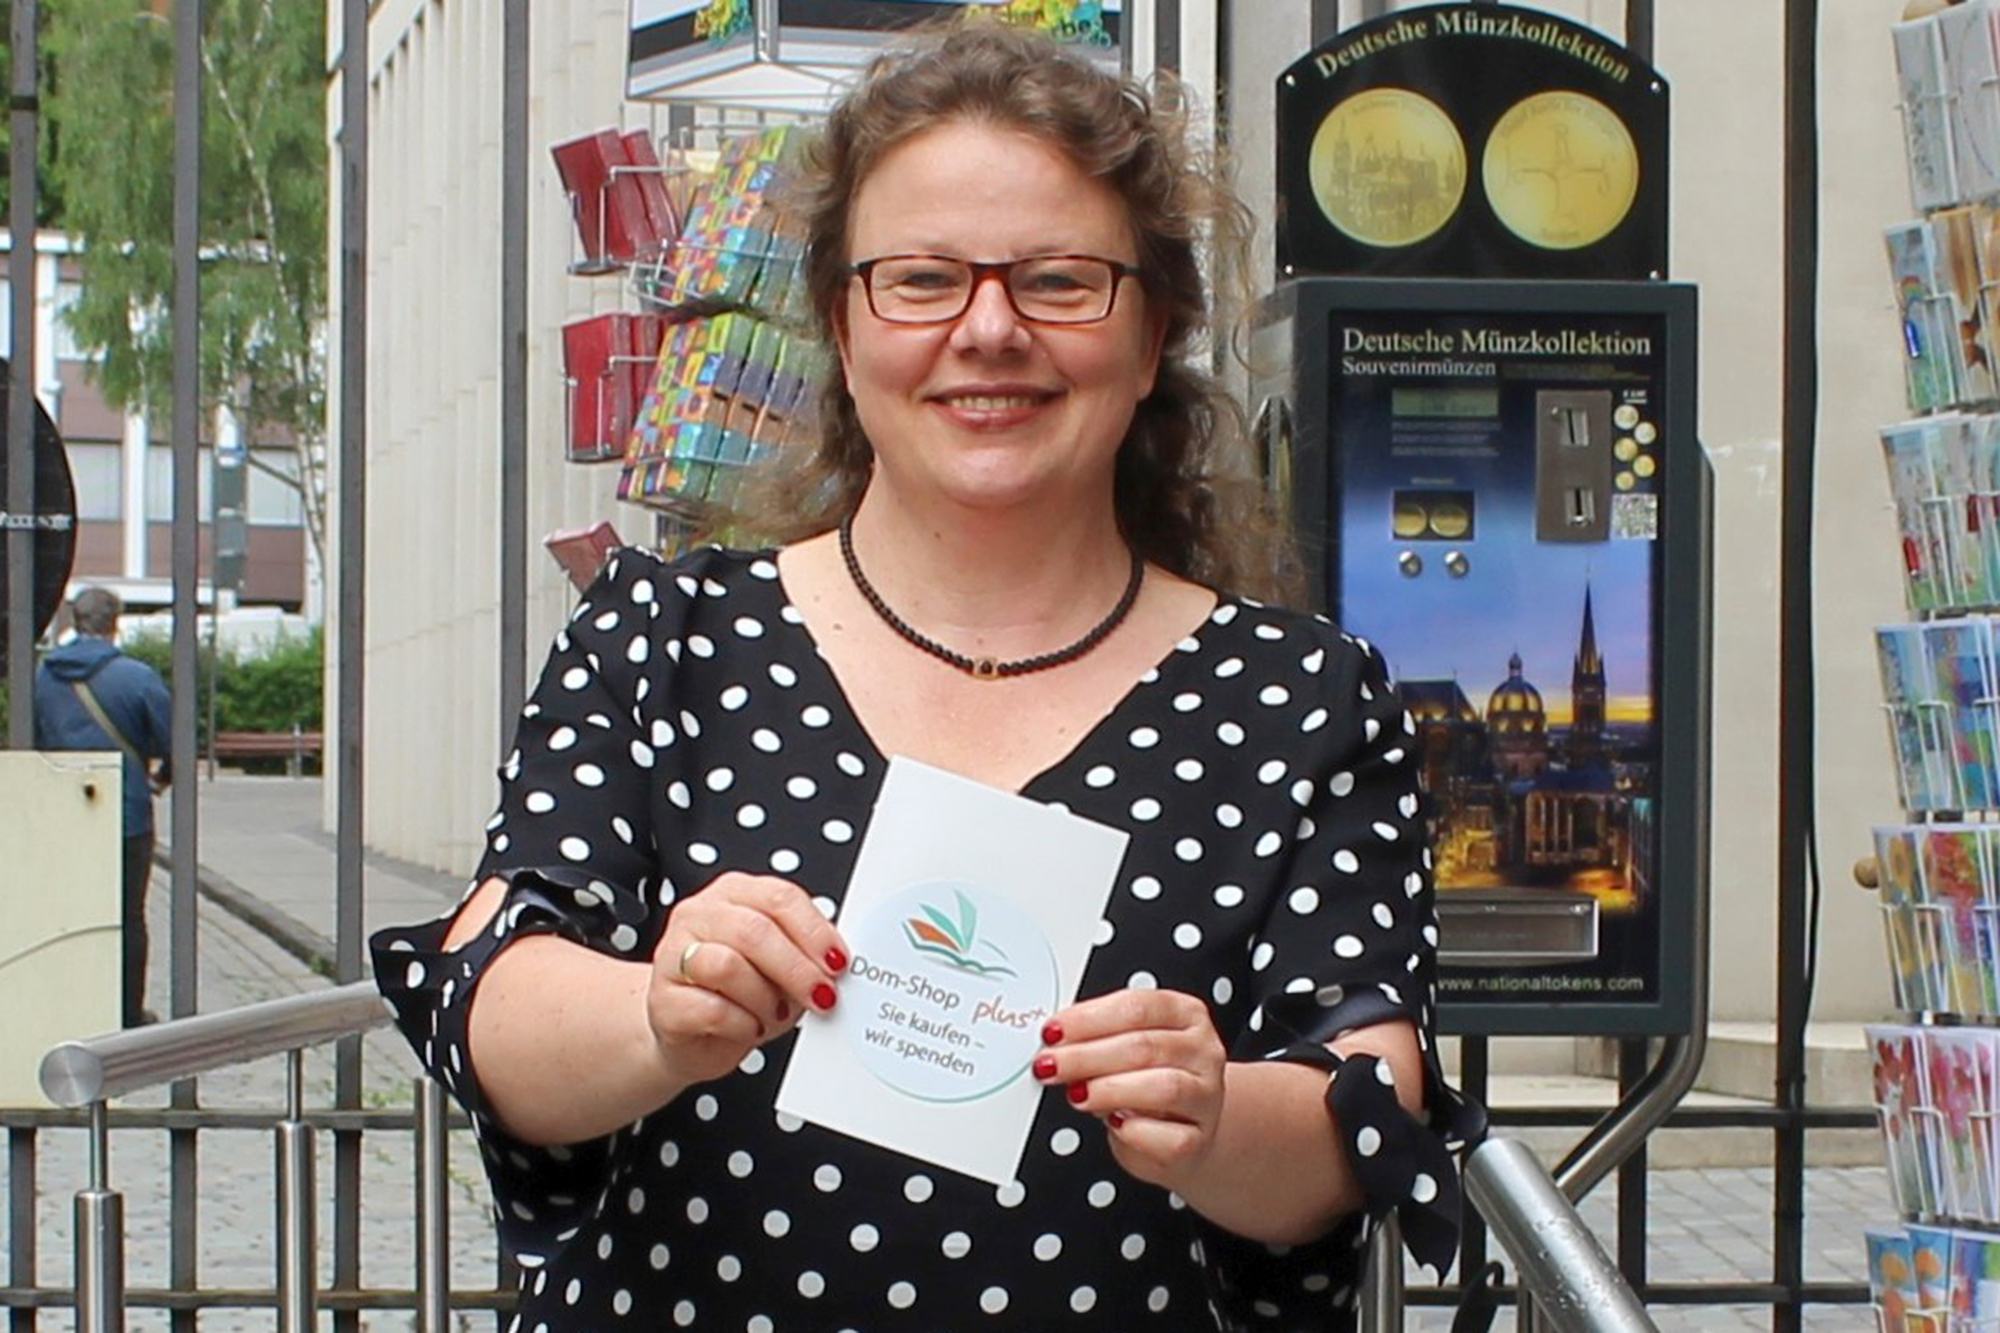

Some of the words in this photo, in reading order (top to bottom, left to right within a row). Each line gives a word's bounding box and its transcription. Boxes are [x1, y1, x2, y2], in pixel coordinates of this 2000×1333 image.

[1315, 17, 1428, 78] Deutsche
[1436, 11, 1630, 84] Münzkollektion
[1343, 328, 1454, 353] Deutsche
[1462, 329, 1651, 356] Münzkollektion
[1342, 356, 1497, 376] Souvenirmünzen
[850, 956, 960, 1009] Dom-Shop
[878, 1002, 906, 1024] Sie
[911, 1012, 970, 1046] kaufen
[864, 1027, 893, 1049] wir
[897, 1037, 975, 1077] spenden
